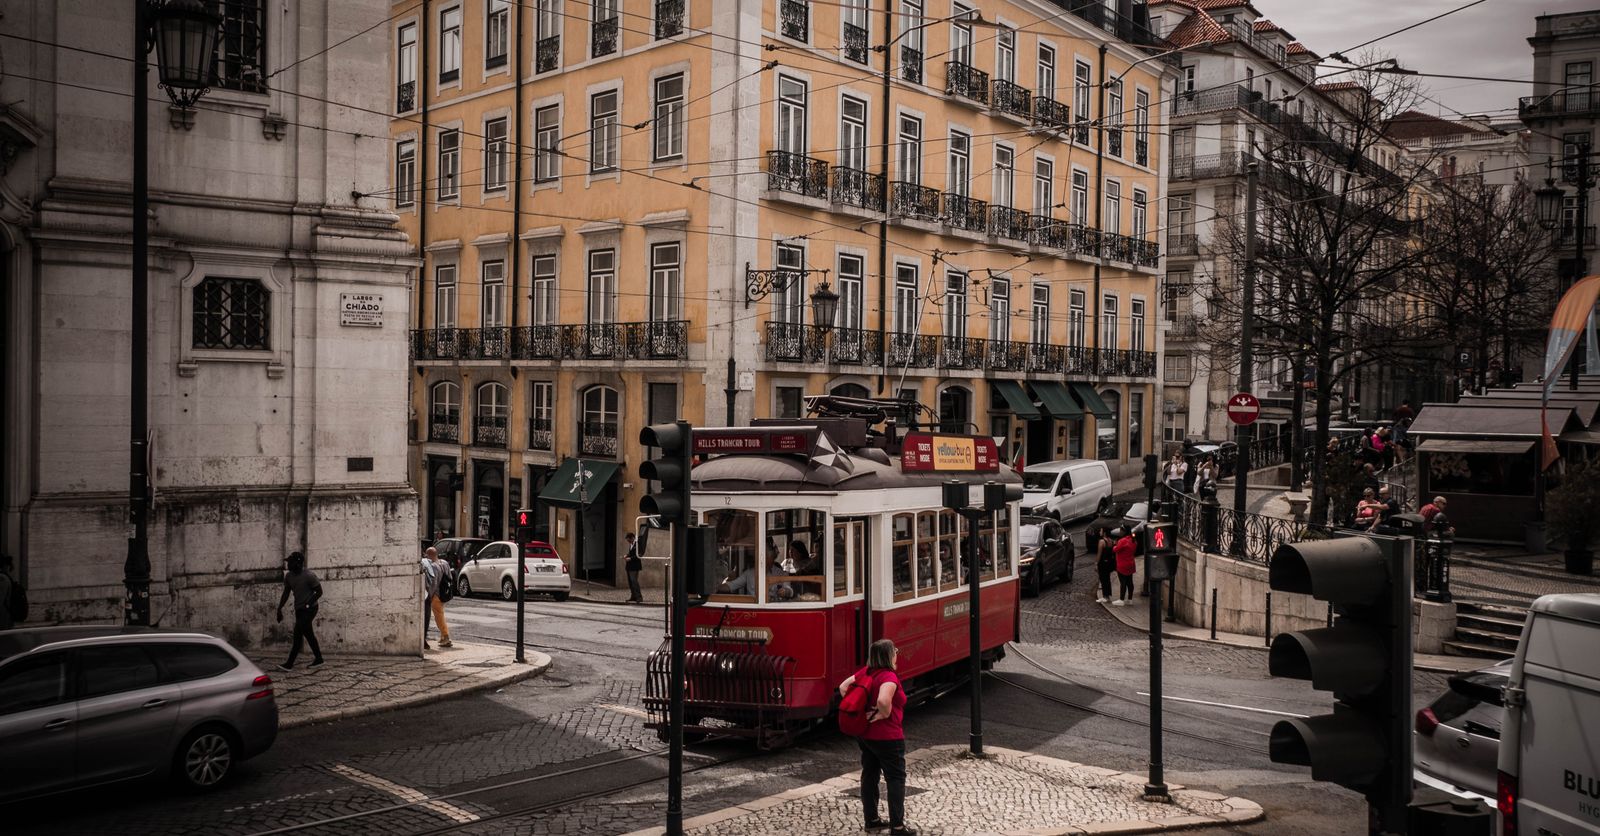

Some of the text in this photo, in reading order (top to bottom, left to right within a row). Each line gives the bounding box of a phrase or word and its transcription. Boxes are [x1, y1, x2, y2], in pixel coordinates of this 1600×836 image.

[1460, 352, 1469, 363] P
[698, 439, 716, 448] HILLS
[744, 439, 760, 447] TOUR
[725, 497, 731, 505] 12
[748, 630, 768, 640] TOUR
[1564, 769, 1600, 799] BLU
[1579, 801, 1600, 817] HYG
